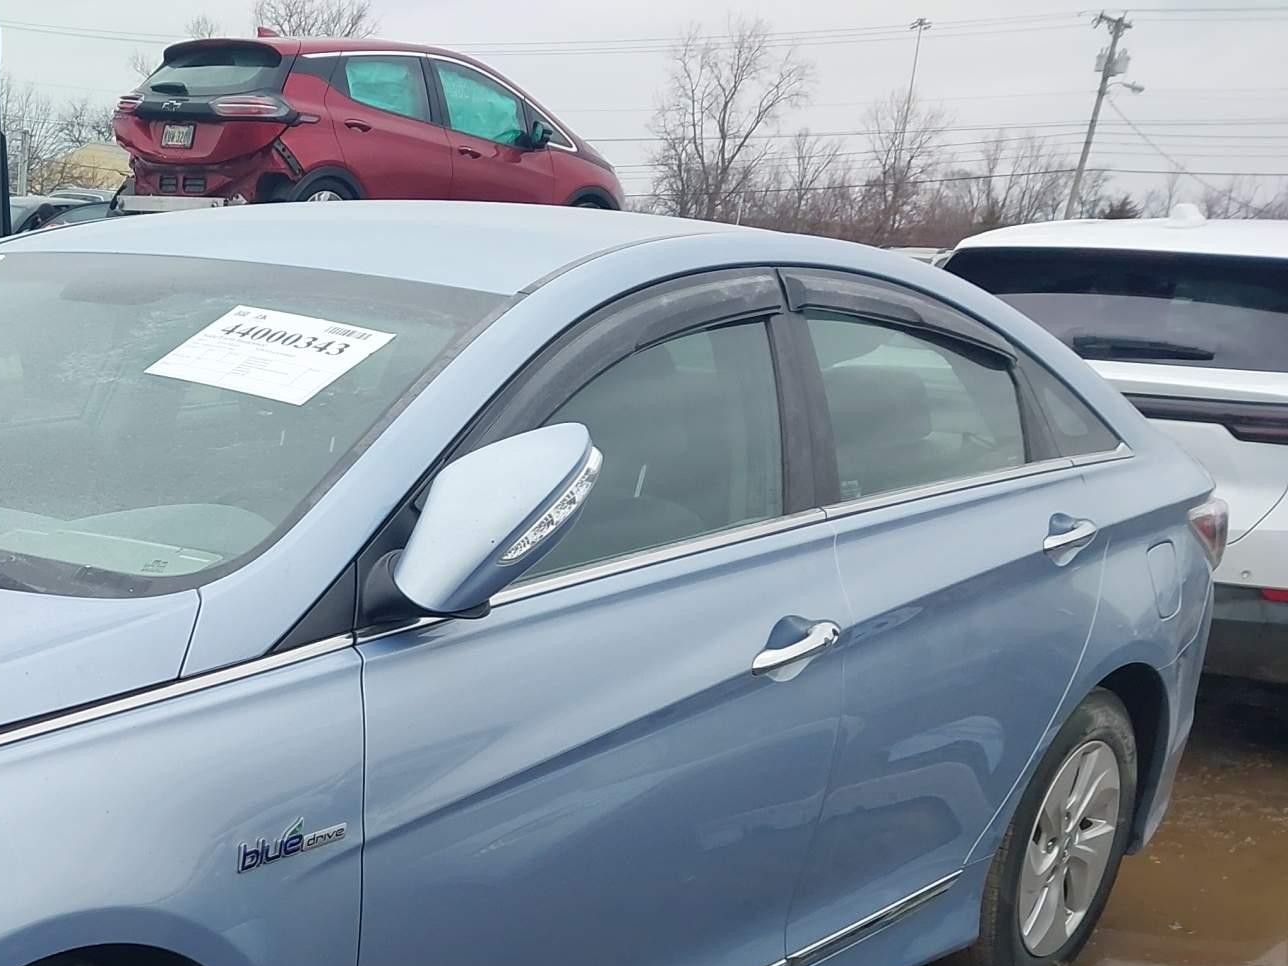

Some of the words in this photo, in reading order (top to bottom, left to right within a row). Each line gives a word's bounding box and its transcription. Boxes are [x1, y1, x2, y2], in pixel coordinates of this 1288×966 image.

[221, 323, 351, 357] 44000343
[237, 831, 304, 874] blue
[306, 827, 346, 848] drive
